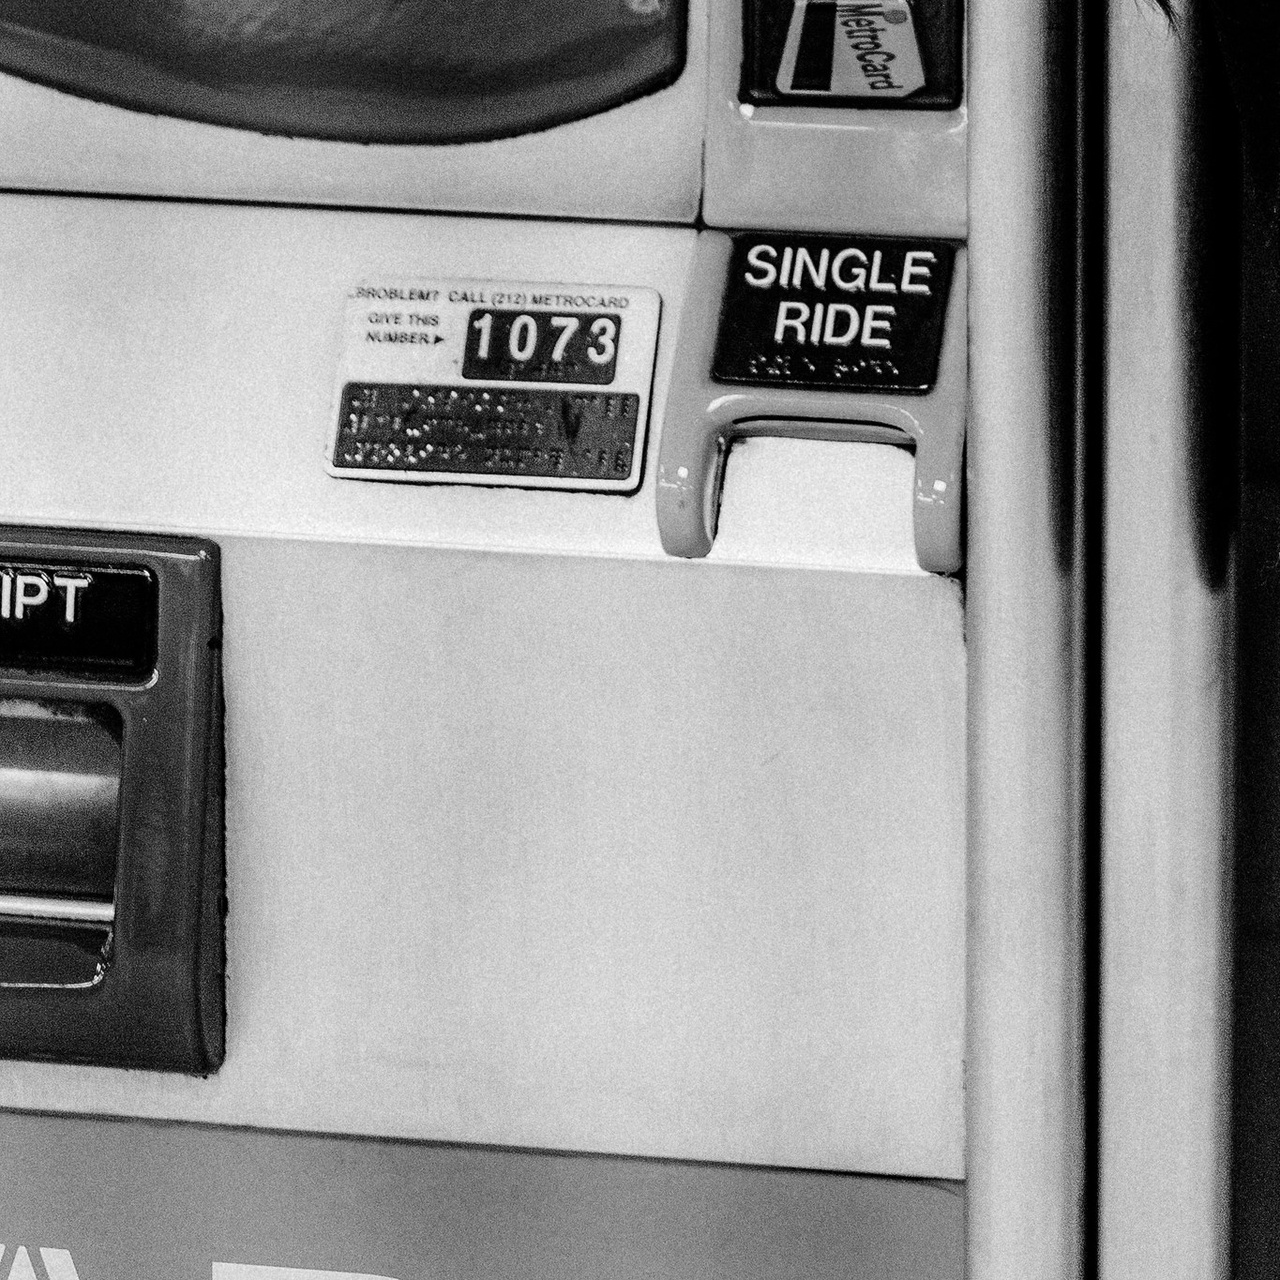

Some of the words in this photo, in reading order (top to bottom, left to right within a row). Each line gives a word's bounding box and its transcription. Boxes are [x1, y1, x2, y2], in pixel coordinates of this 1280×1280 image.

[837, 3, 904, 90] MetroCard
[745, 244, 937, 294] SINGLE
[368, 312, 401, 325] GIVE
[408, 314, 440, 327] THIS
[449, 290, 486, 304] CALL
[491, 291, 528, 307] (212)
[531, 294, 630, 309] METROCARD
[473, 312, 617, 364] 1073
[774, 301, 897, 348] RIDE
